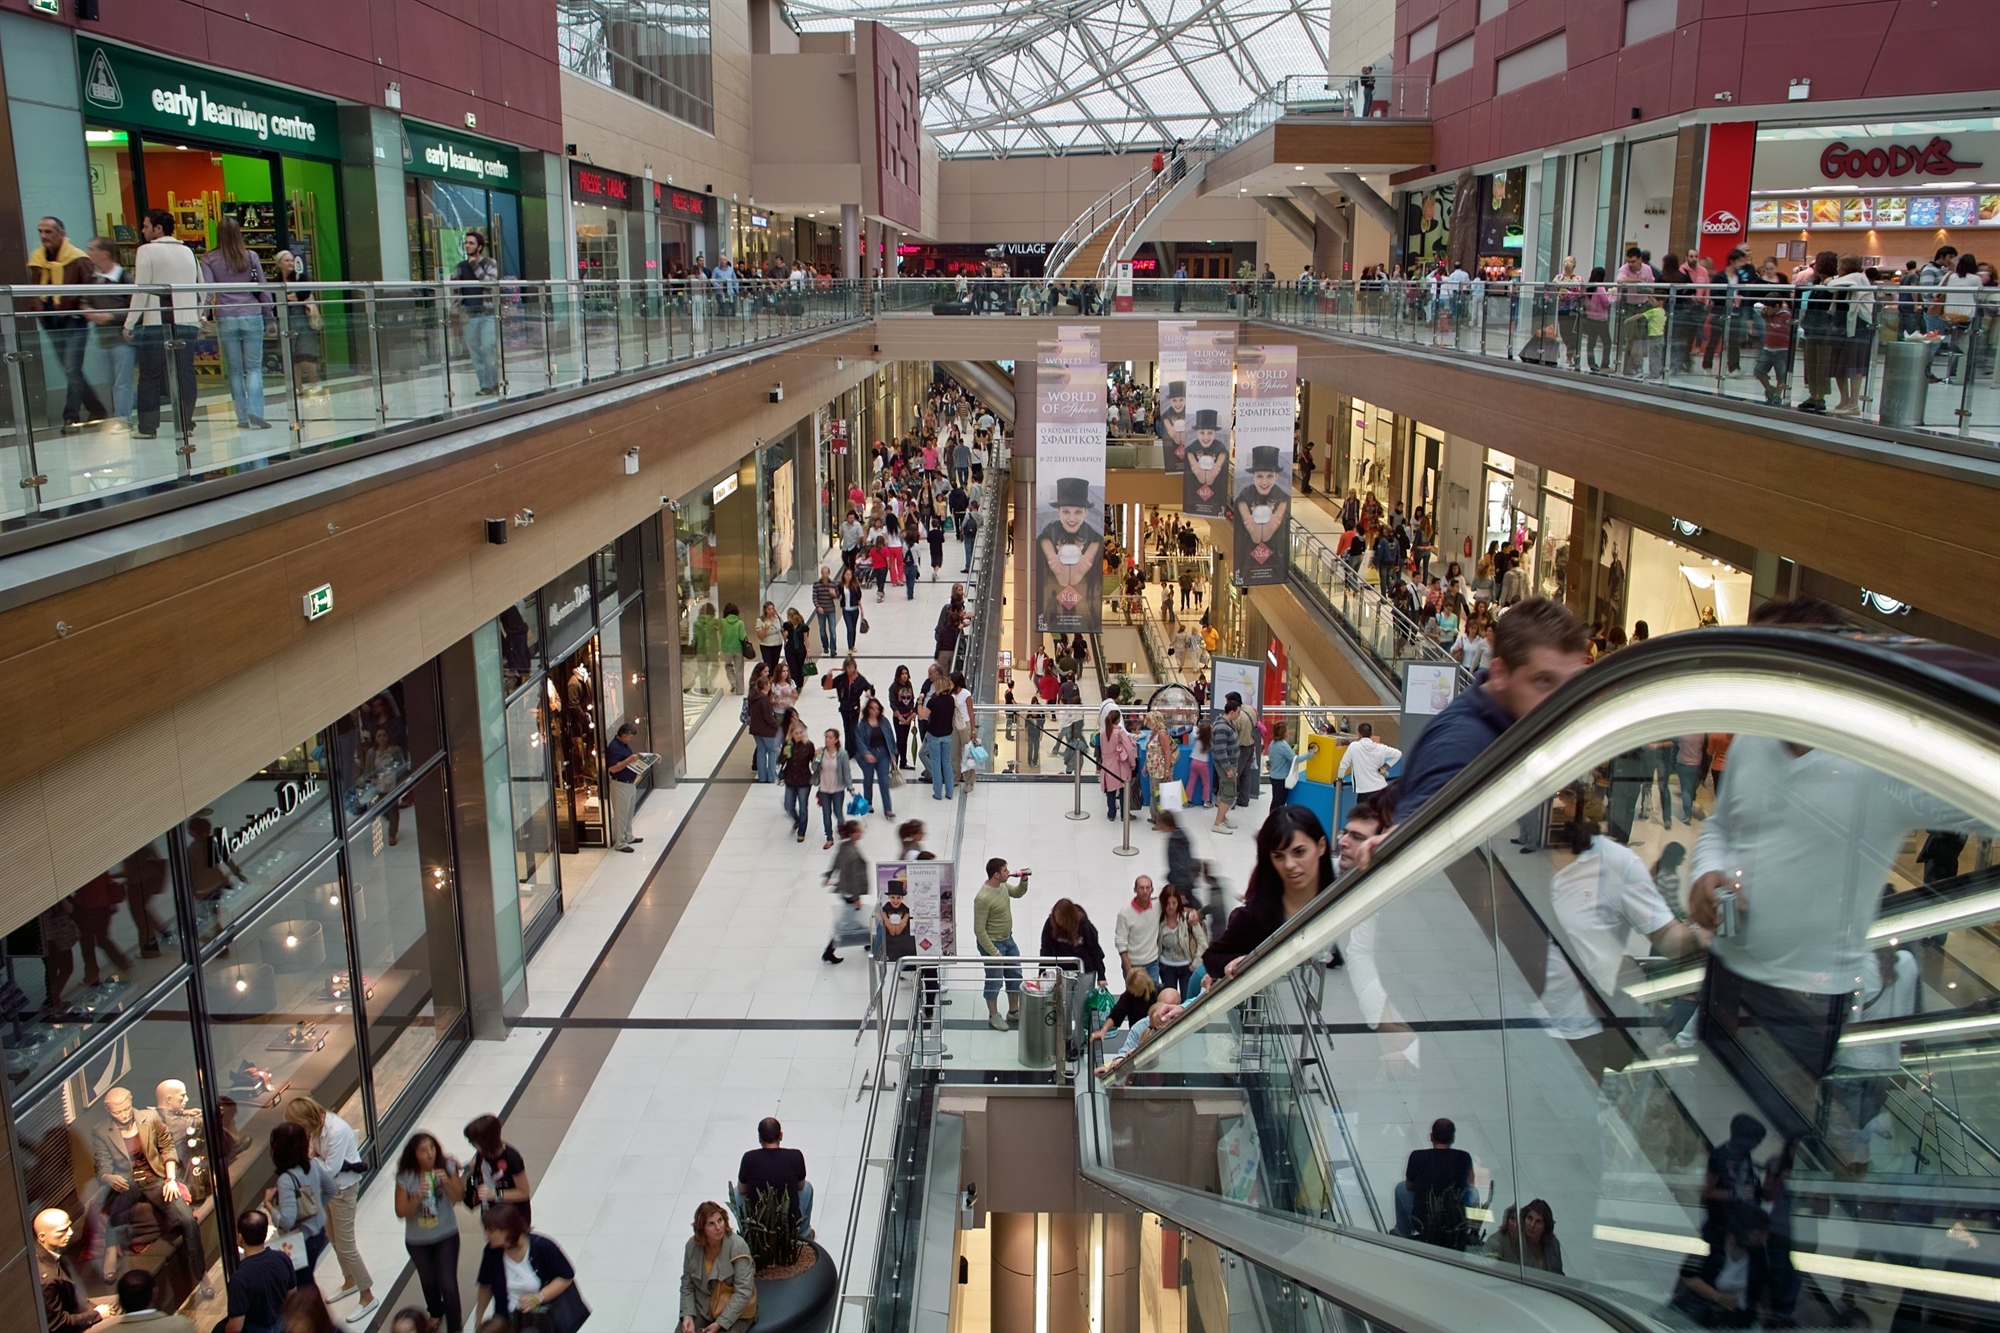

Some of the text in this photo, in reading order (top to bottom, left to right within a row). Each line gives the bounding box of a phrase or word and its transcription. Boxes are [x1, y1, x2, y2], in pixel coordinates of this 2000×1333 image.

[152, 84, 316, 141] early learning centre
[425, 143, 448, 172] early
[449, 145, 484, 179] learning
[484, 159, 509, 178] centre
[1819, 135, 1984, 179] GOODY'S
[579, 170, 601, 194] PRESSE
[606, 177, 627, 199] TABAC
[671, 193, 687, 211] PRESSE
[1008, 243, 1046, 254] VILLAGE
[1246, 370, 1288, 379] WORLD
[1241, 380, 1289, 393] OF Sphere
[1047, 392, 1097, 402] WORLD
[1042, 402, 1099, 418] OF Sphere
[1239, 408, 1291, 417] ΣΦΑΙΡΙΚΟΣ
[1041, 435, 1102, 445] ΣΦΑΙΡΙΚΟΣ
[213, 772, 320, 868] Massimo Dutti
